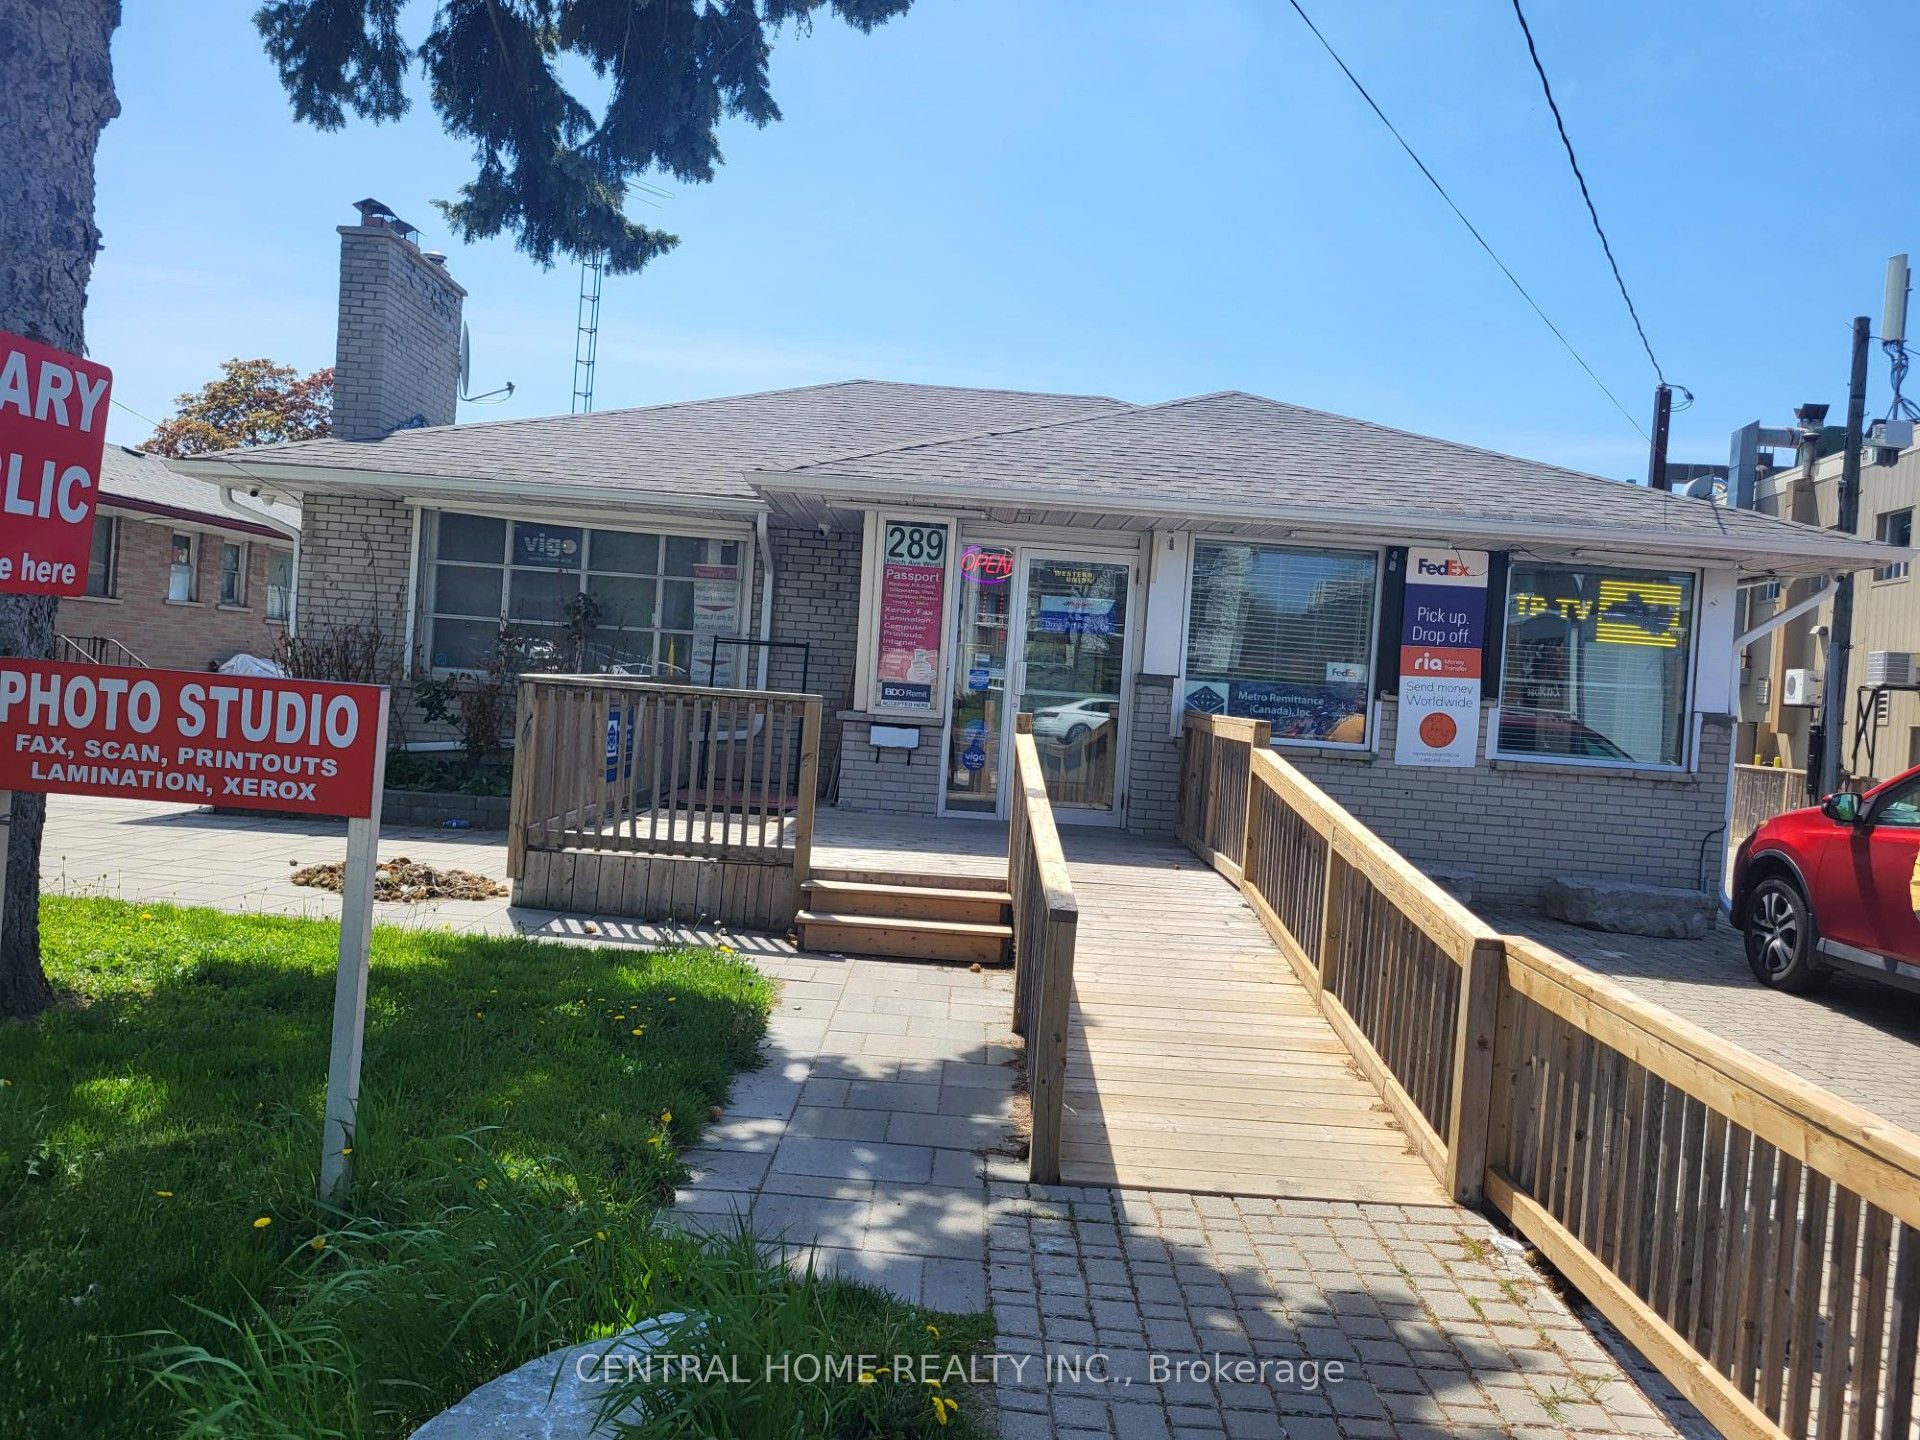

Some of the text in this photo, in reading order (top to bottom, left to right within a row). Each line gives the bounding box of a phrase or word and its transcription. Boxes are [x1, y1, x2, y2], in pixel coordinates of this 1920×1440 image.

[0, 452, 91, 523] LIC
[524, 533, 577, 557] vigo
[889, 527, 943, 560] 289
[21, 552, 76, 585] here
[961, 553, 1013, 575] OPEN
[1418, 558, 1469, 577] FedEx
[886, 569, 940, 583] Passport
[1054, 570, 1093, 578] WESTERN
[885, 606, 911, 614] Xerox
[1417, 606, 1470, 628] Pick up.
[883, 622, 928, 632] Computer
[884, 613, 934, 625] Lamination,
[883, 630, 925, 640] Printouts,
[1412, 625, 1472, 645] Drop off.
[1414, 652, 1442, 670] ria
[1444, 659, 1465, 667] Money
[885, 686, 927, 698] BDO Remit
[1406, 680, 1474, 695] Send money
[1238, 690, 1324, 706] Metro Remittance
[1406, 694, 1474, 708] Worldwide
[0, 670, 359, 749] PHOTO STUDIO
[16, 733, 338, 777] FAX, SCAN, PRINTOUTS
[964, 752, 985, 762] vigo
[31, 761, 317, 801] LAMINATION, XEROX
